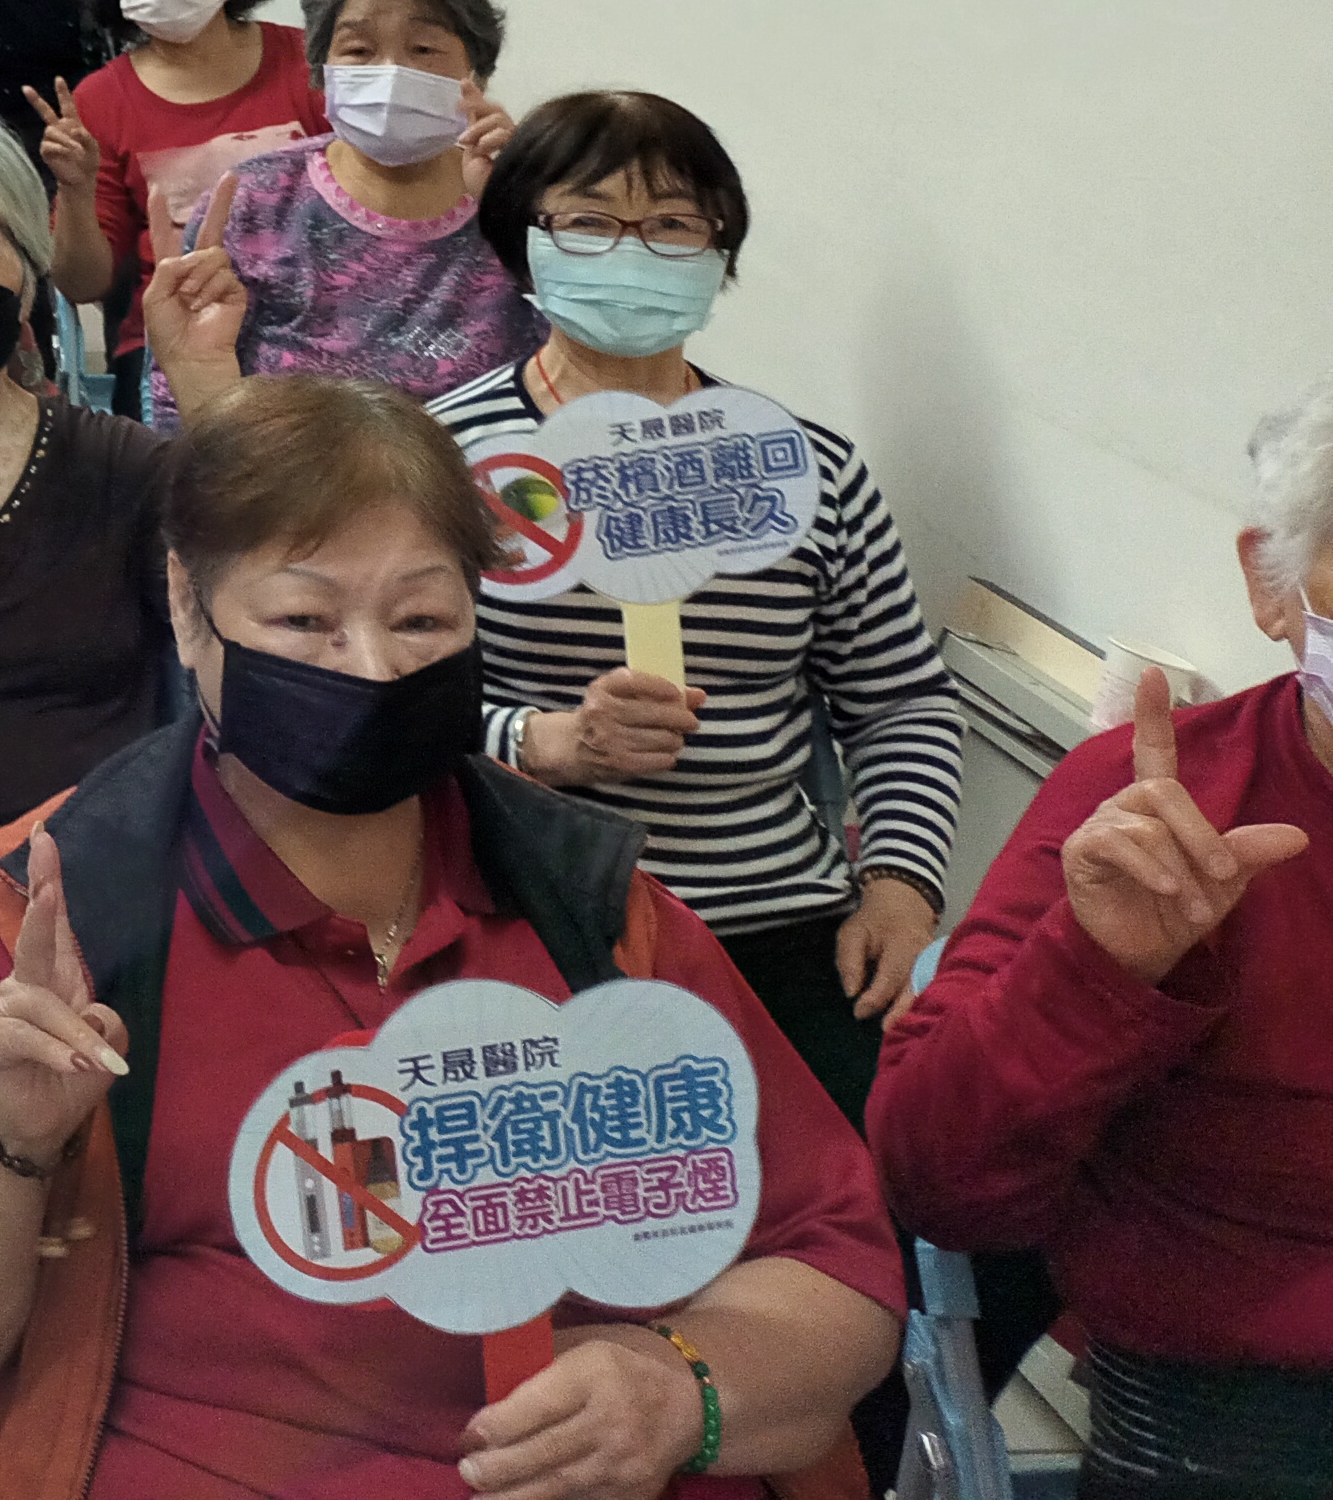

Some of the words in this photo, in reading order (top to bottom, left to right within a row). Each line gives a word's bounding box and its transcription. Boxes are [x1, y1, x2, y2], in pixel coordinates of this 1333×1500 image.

[609, 407, 727, 445] 天晟醫院
[596, 484, 799, 561] 健康長久
[396, 1036, 563, 1092] 天晟醫院
[401, 1054, 736, 1191] 捍衛健康
[420, 1147, 738, 1254] 全面禁止電子煙
